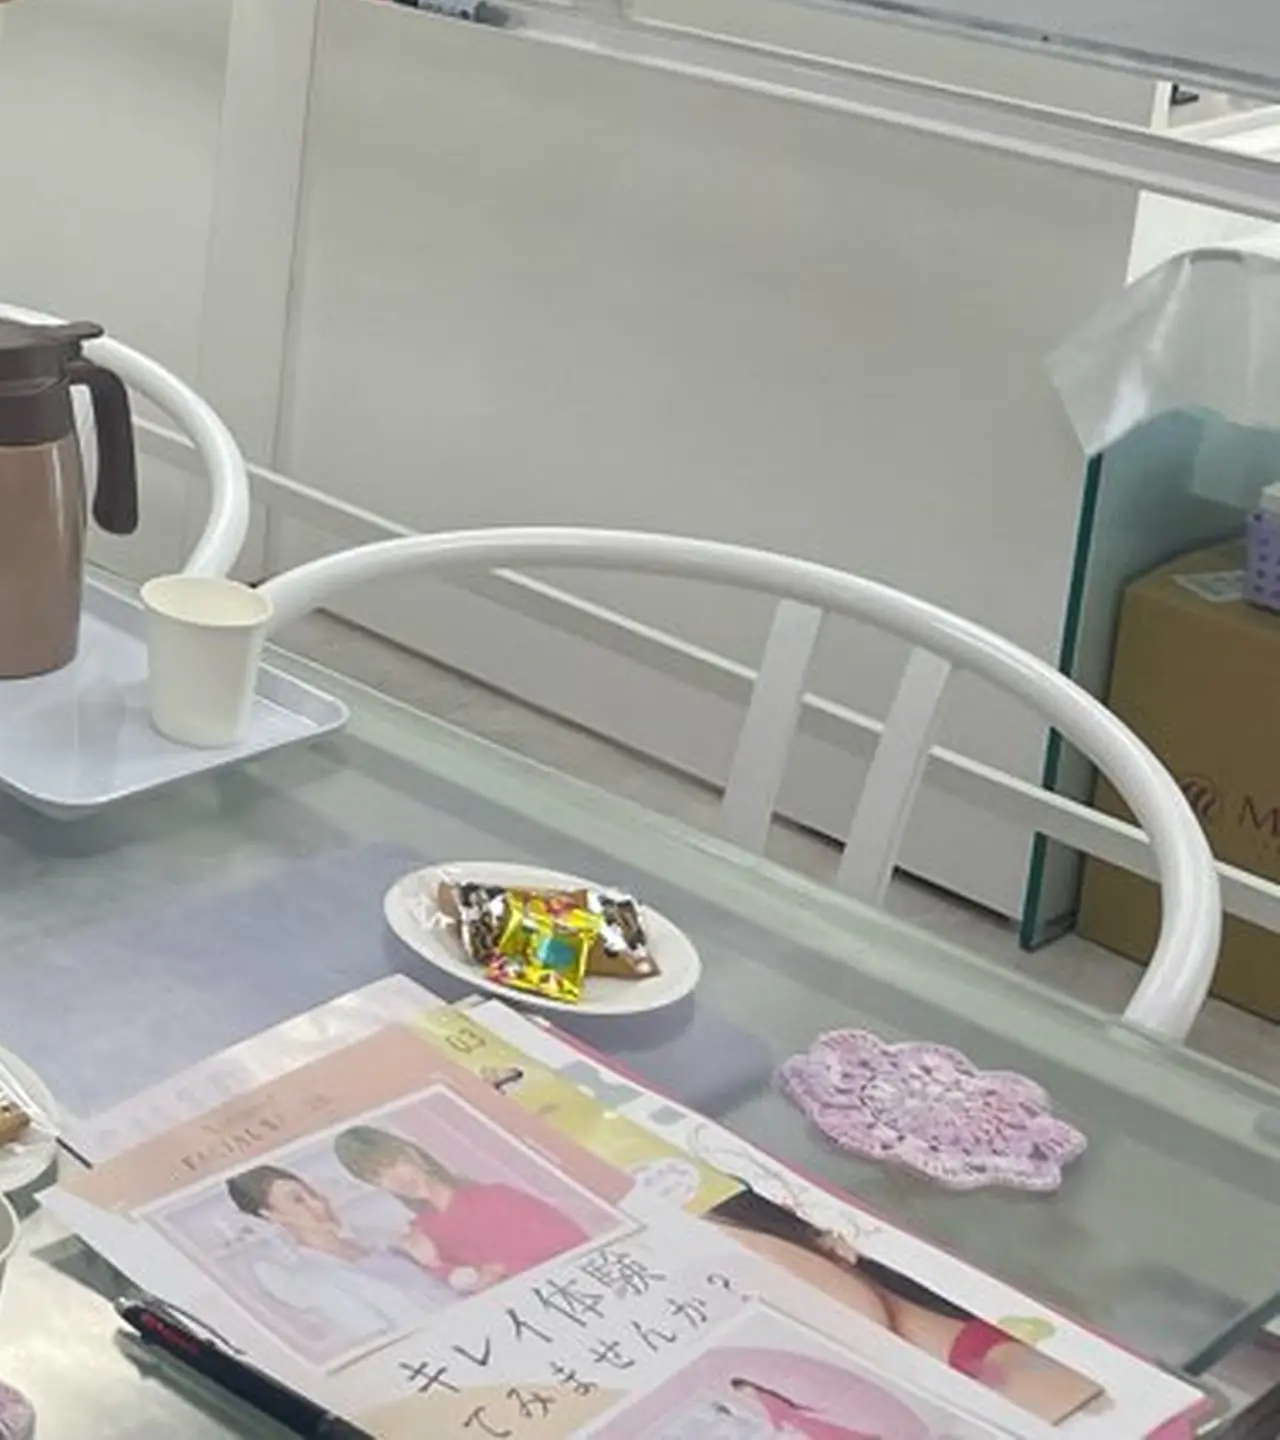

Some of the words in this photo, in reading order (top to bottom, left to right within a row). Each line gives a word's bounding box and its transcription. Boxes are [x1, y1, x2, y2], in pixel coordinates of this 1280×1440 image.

[397, 1248, 666, 1393] キレイ体験
